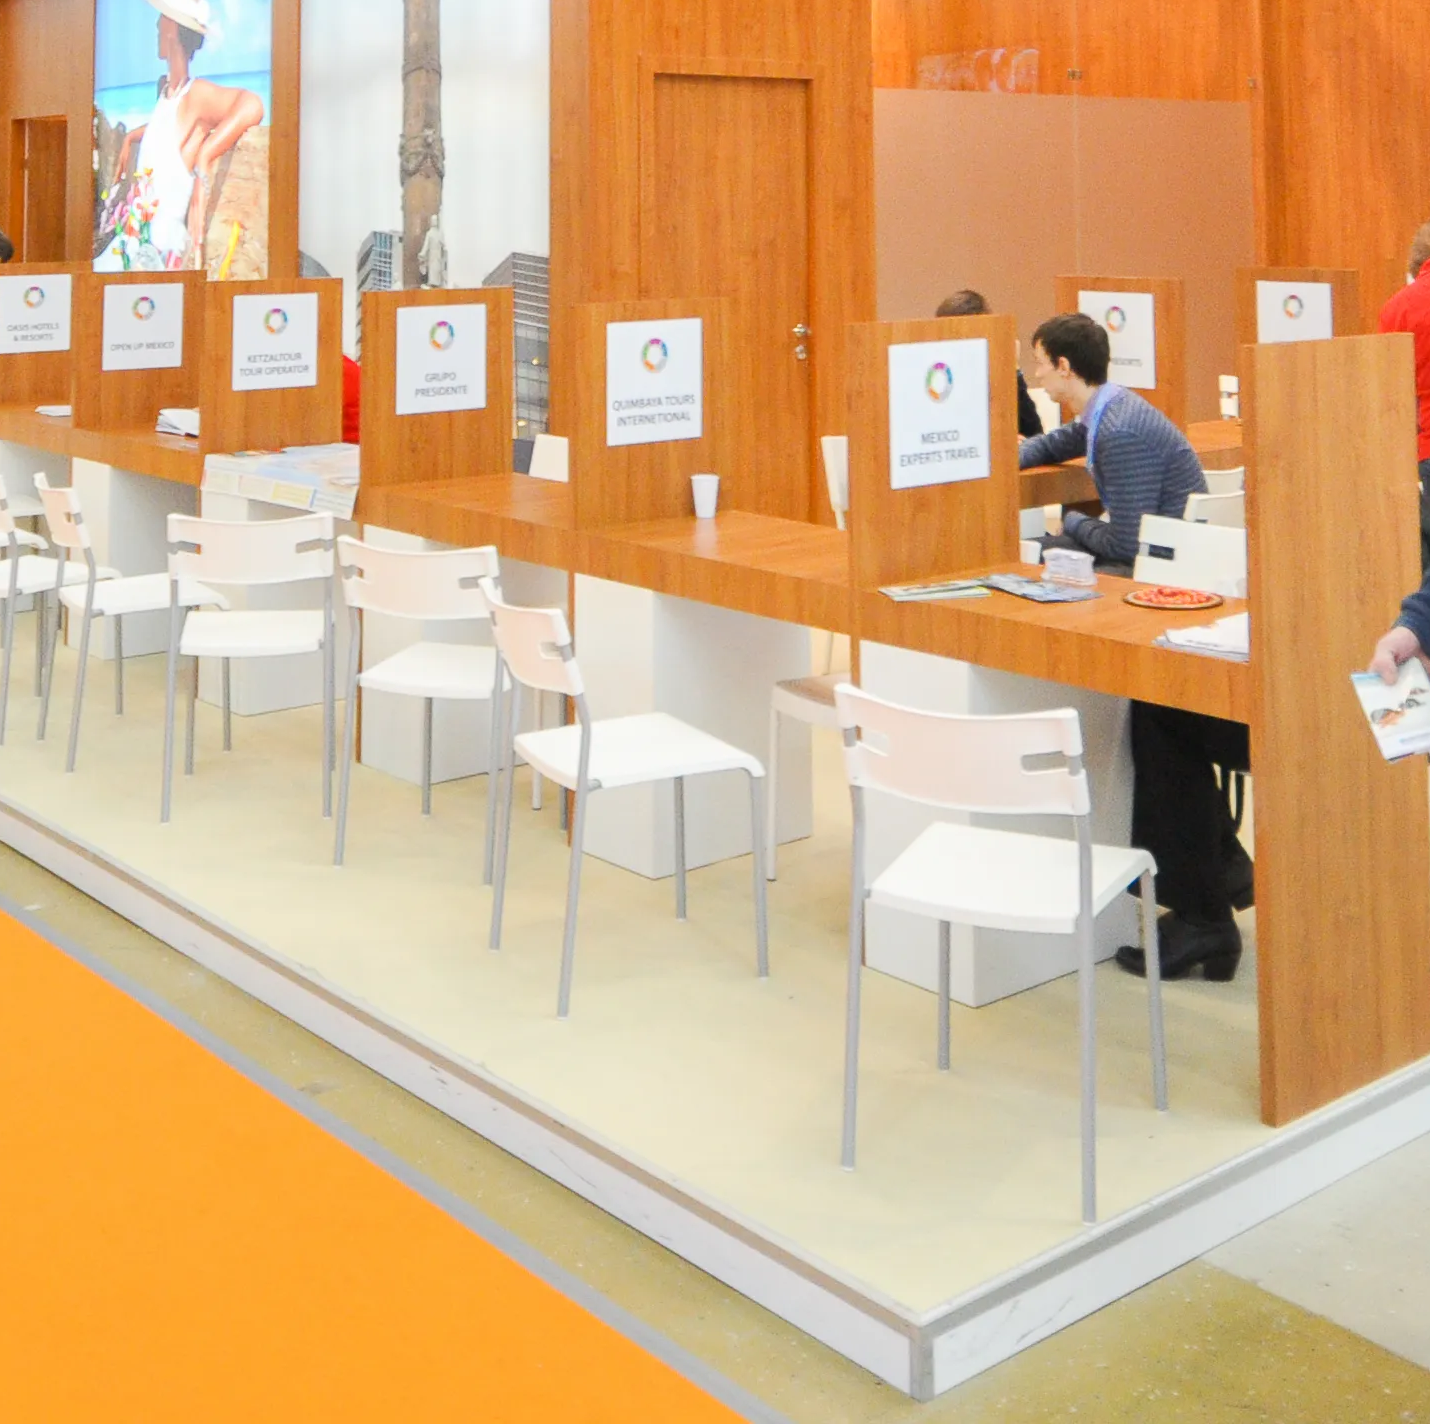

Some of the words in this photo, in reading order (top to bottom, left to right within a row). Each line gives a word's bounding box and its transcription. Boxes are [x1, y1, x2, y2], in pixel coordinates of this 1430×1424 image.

[7, 324, 30, 332] OASIS
[31, 322, 59, 331] HOTELS
[20, 333, 54, 342] RESORTS
[110, 343, 132, 352] OPEN
[133, 343, 144, 351] UP
[145, 341, 175, 351] MEXICO
[247, 352, 302, 364] KETZALTOUR
[239, 366, 263, 377] TOUR
[264, 364, 310, 375] OPERATOR
[424, 372, 456, 383] GRUPO
[415, 384, 469, 398] PRESIDENTE
[612, 396, 662, 412] QUIMBAYA
[664, 394, 696, 408] TOURS
[616, 411, 691, 428] INTERNETIONAL
[920, 430, 960, 445] MEXICO
[900, 450, 942, 468] EXPERTS
[945, 447, 981, 463] TRAVEL
